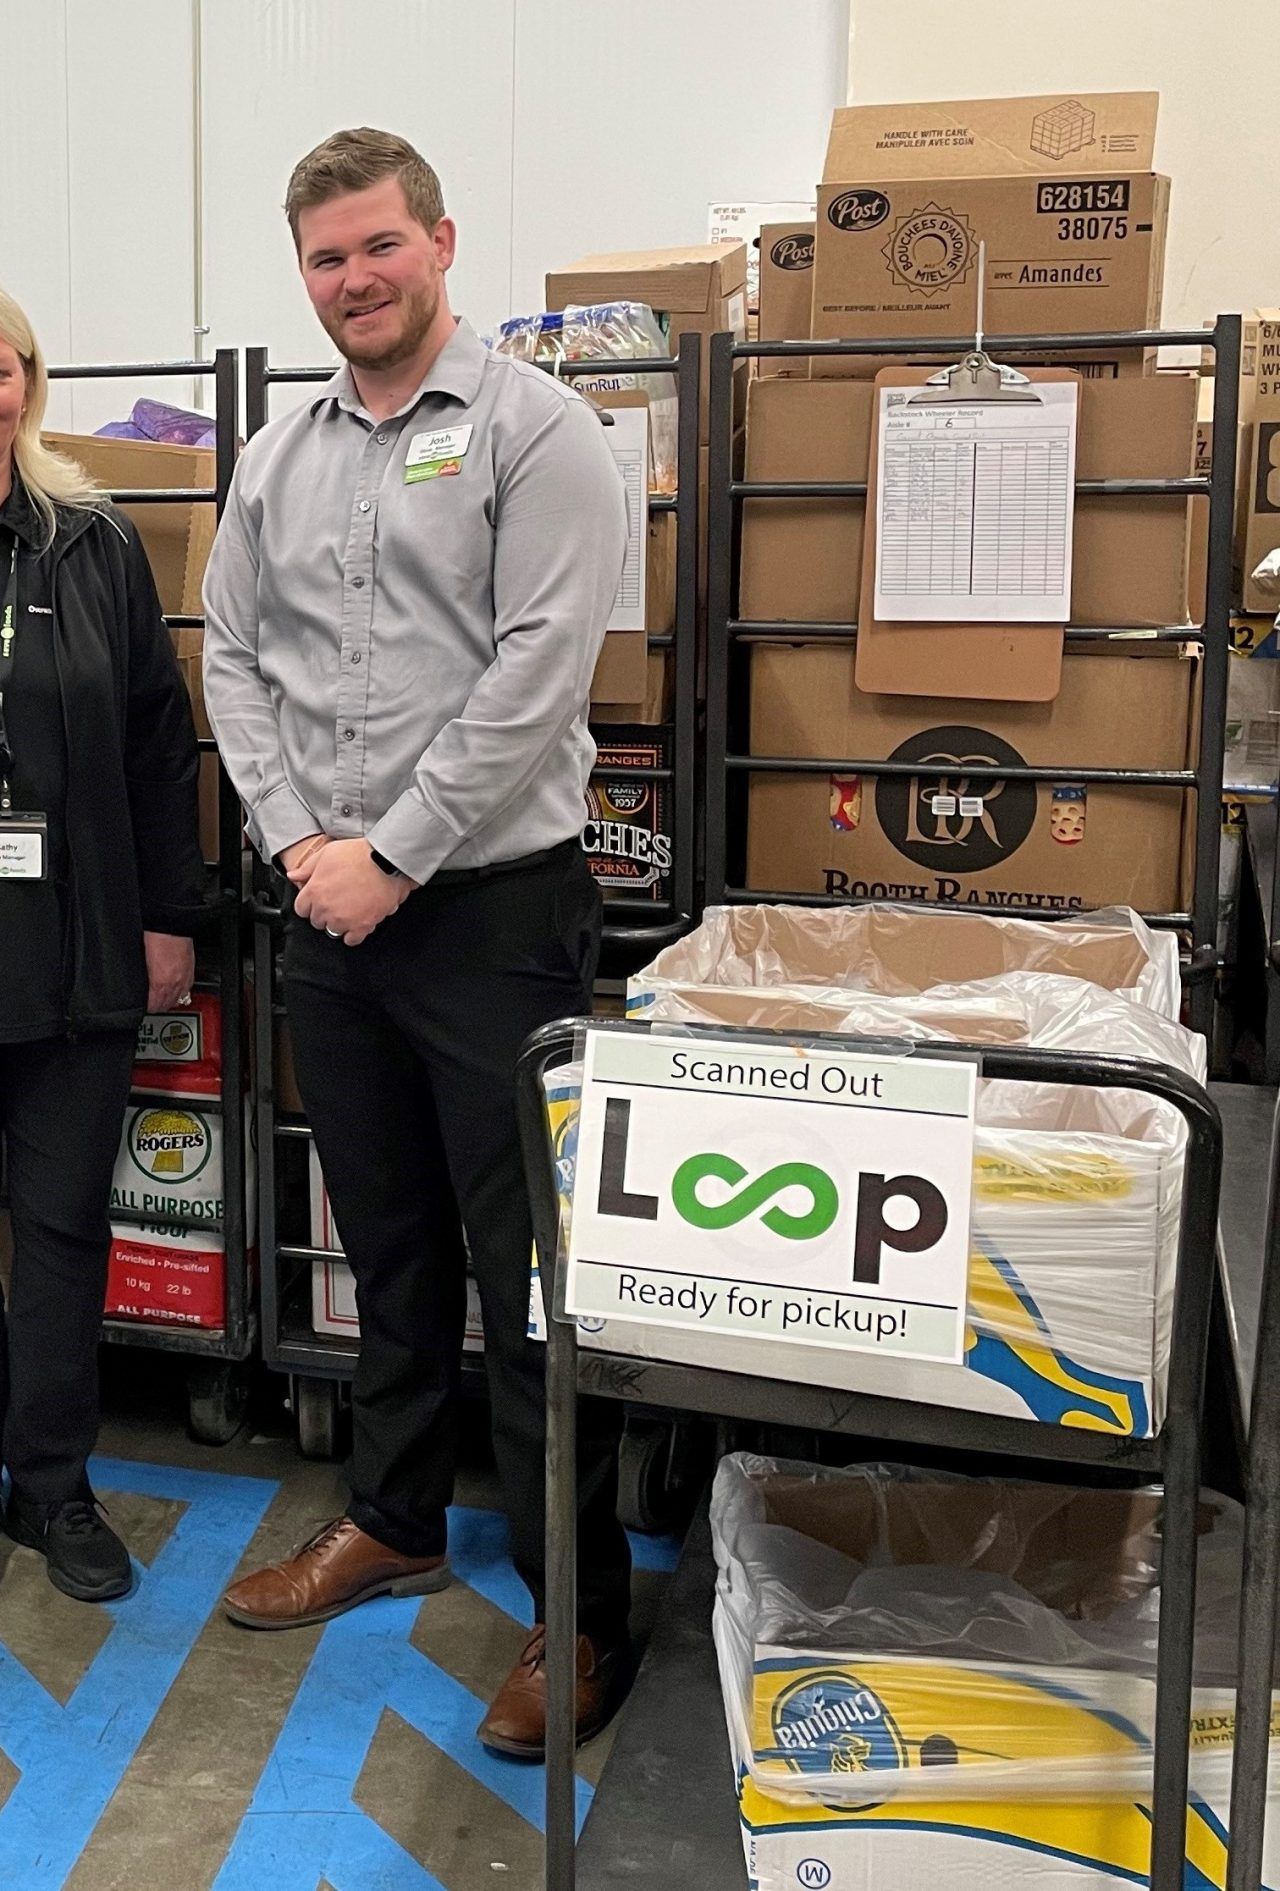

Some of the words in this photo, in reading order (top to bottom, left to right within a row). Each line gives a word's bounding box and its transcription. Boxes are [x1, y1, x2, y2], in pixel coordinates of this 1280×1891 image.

[876, 139, 926, 149] MANIPULER
[928, 138, 950, 147] AVEC
[952, 137, 974, 145] SOIN
[921, 130, 943, 138] WITH
[945, 129, 968, 137] CARE
[1040, 184, 1124, 211] 628154
[837, 196, 883, 225] Post
[1057, 216, 1128, 240] 38075
[939, 220, 964, 271] D'AVOINE
[915, 269, 948, 283] MIEL
[994, 270, 1013, 280] avec
[1019, 263, 1102, 284] Amandes
[844, 304, 876, 312] BEFORE
[882, 304, 923, 312] MEILLEUR
[924, 303, 951, 311] AVANT
[945, 418, 954, 428] 6
[429, 434, 451, 446] Josh
[580, 819, 673, 868] CHES
[822, 869, 929, 899] BOOTH
[670, 1053, 810, 1091] Scanned
[821, 1067, 884, 1098] Out
[136, 1134, 204, 1151] ROGERS
[597, 1097, 948, 1285] Loop
[110, 1187, 139, 1209] ALL
[143, 1194, 224, 1219] PURPOSE
[116, 1252, 155, 1267] Enriched
[163, 1260, 210, 1273] Pre-sifted
[126, 1277, 136, 1288] 10
[138, 1279, 151, 1292] kg
[166, 1284, 179, 1295] 22
[182, 1285, 191, 1296] lb
[117, 1304, 139, 1315] ALL
[143, 1307, 201, 1324] PURPOSE
[619, 1274, 718, 1319] Ready
[727, 1287, 773, 1319] for
[782, 1299, 908, 1342] pickup!
[775, 1690, 882, 1750] Chiquita
